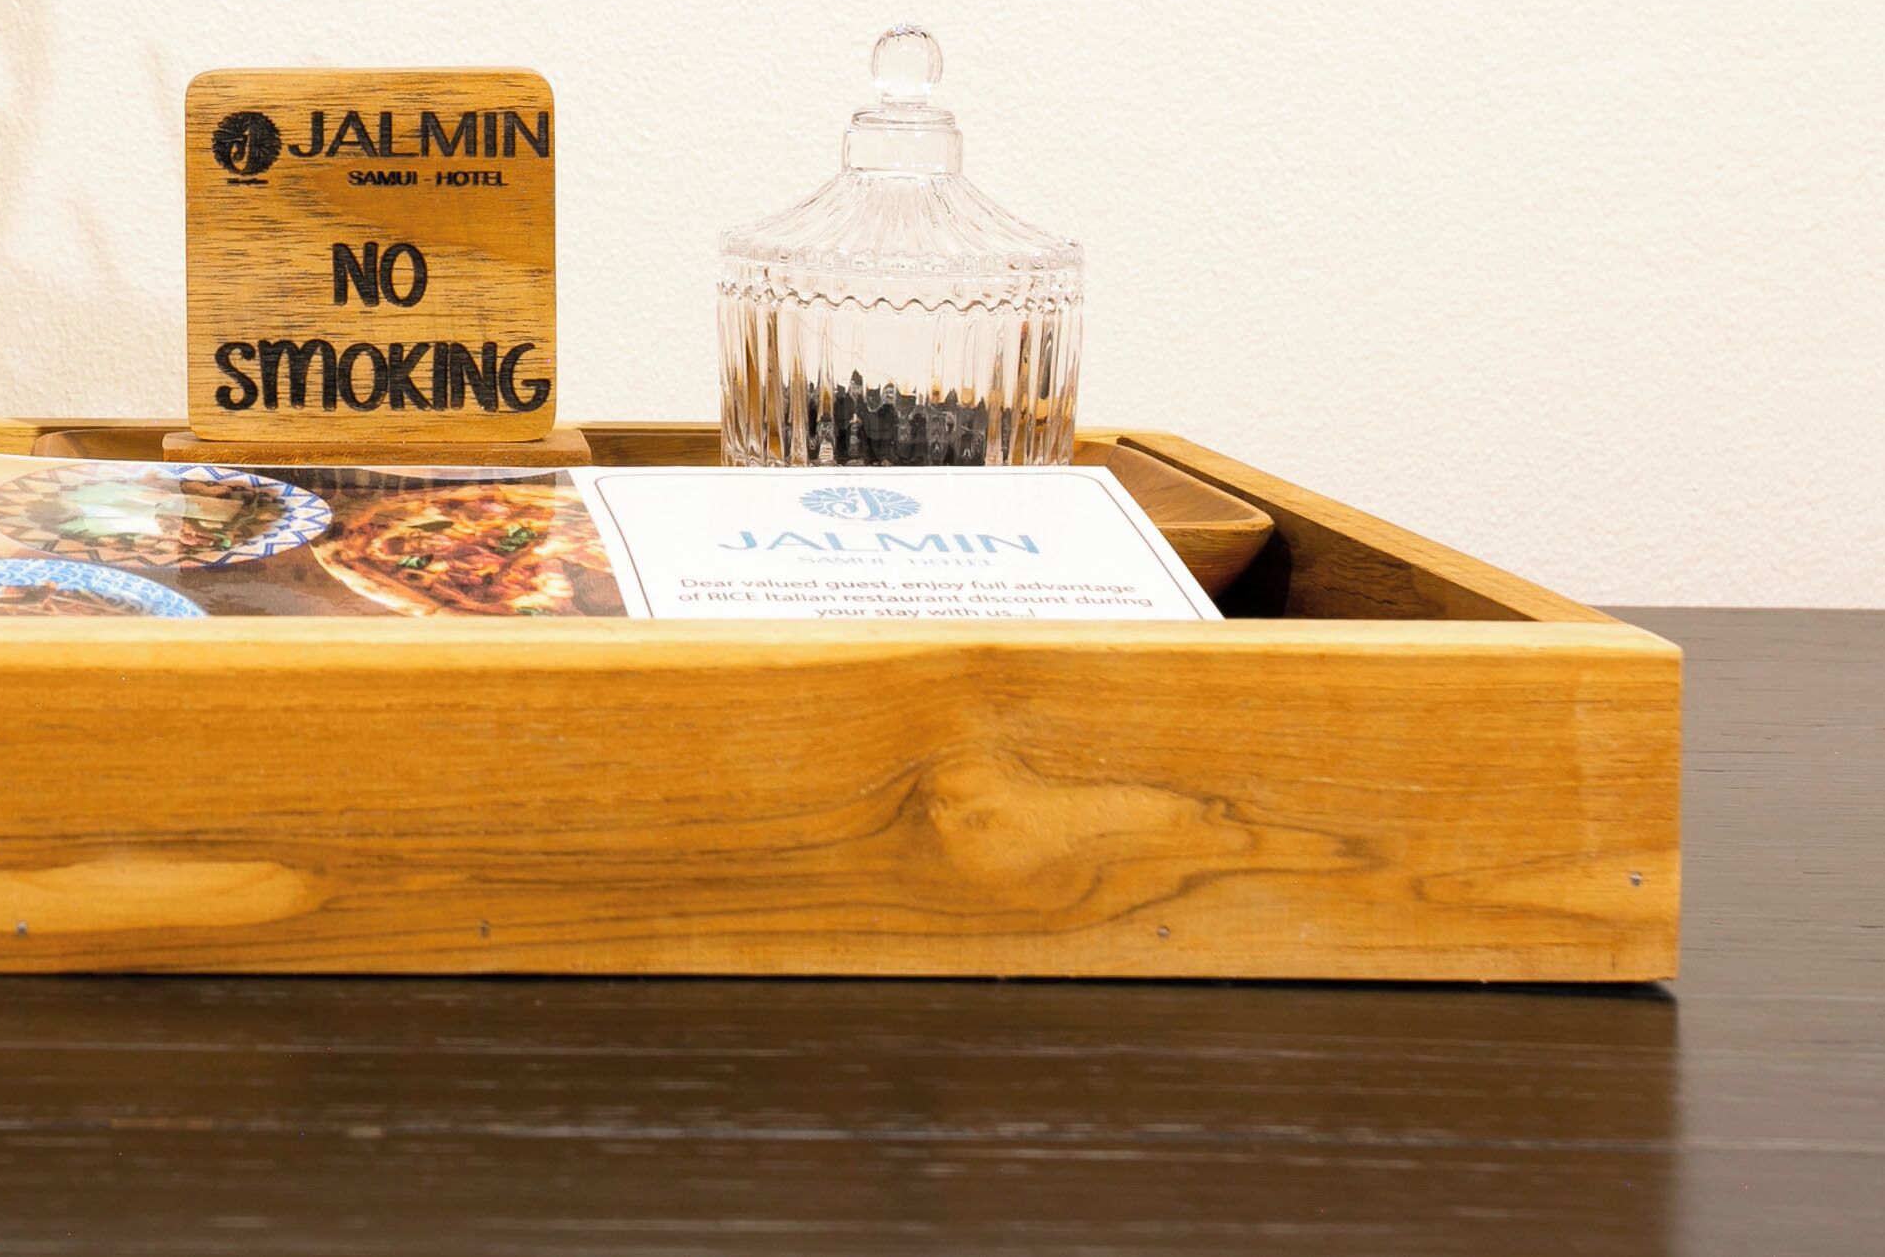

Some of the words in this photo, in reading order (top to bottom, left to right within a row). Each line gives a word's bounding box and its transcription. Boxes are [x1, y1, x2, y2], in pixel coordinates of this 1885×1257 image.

[287, 110, 550, 159] JALMIN
[348, 170, 418, 186] SAMUI
[435, 170, 510, 186] HOTEL
[332, 241, 428, 308] NO
[214, 338, 551, 412] SMOKING
[717, 531, 1041, 554] JALMIN
[680, 578, 734, 588] Dear
[740, 579, 818, 589] valued
[825, 580, 897, 591] guest,
[902, 581, 964, 591] enjoy
[971, 581, 1007, 591] full
[1014, 581, 1138, 594] advantage
[678, 592, 700, 602] of
[707, 593, 757, 602] RICE
[765, 593, 836, 602] Italian
[843, 593, 962, 603] restaurant
[968, 594, 1068, 604] discount
[1075, 595, 1154, 607] during
[814, 607, 867, 619] your
[874, 607, 920, 618] stay
[926, 607, 979, 617] with
